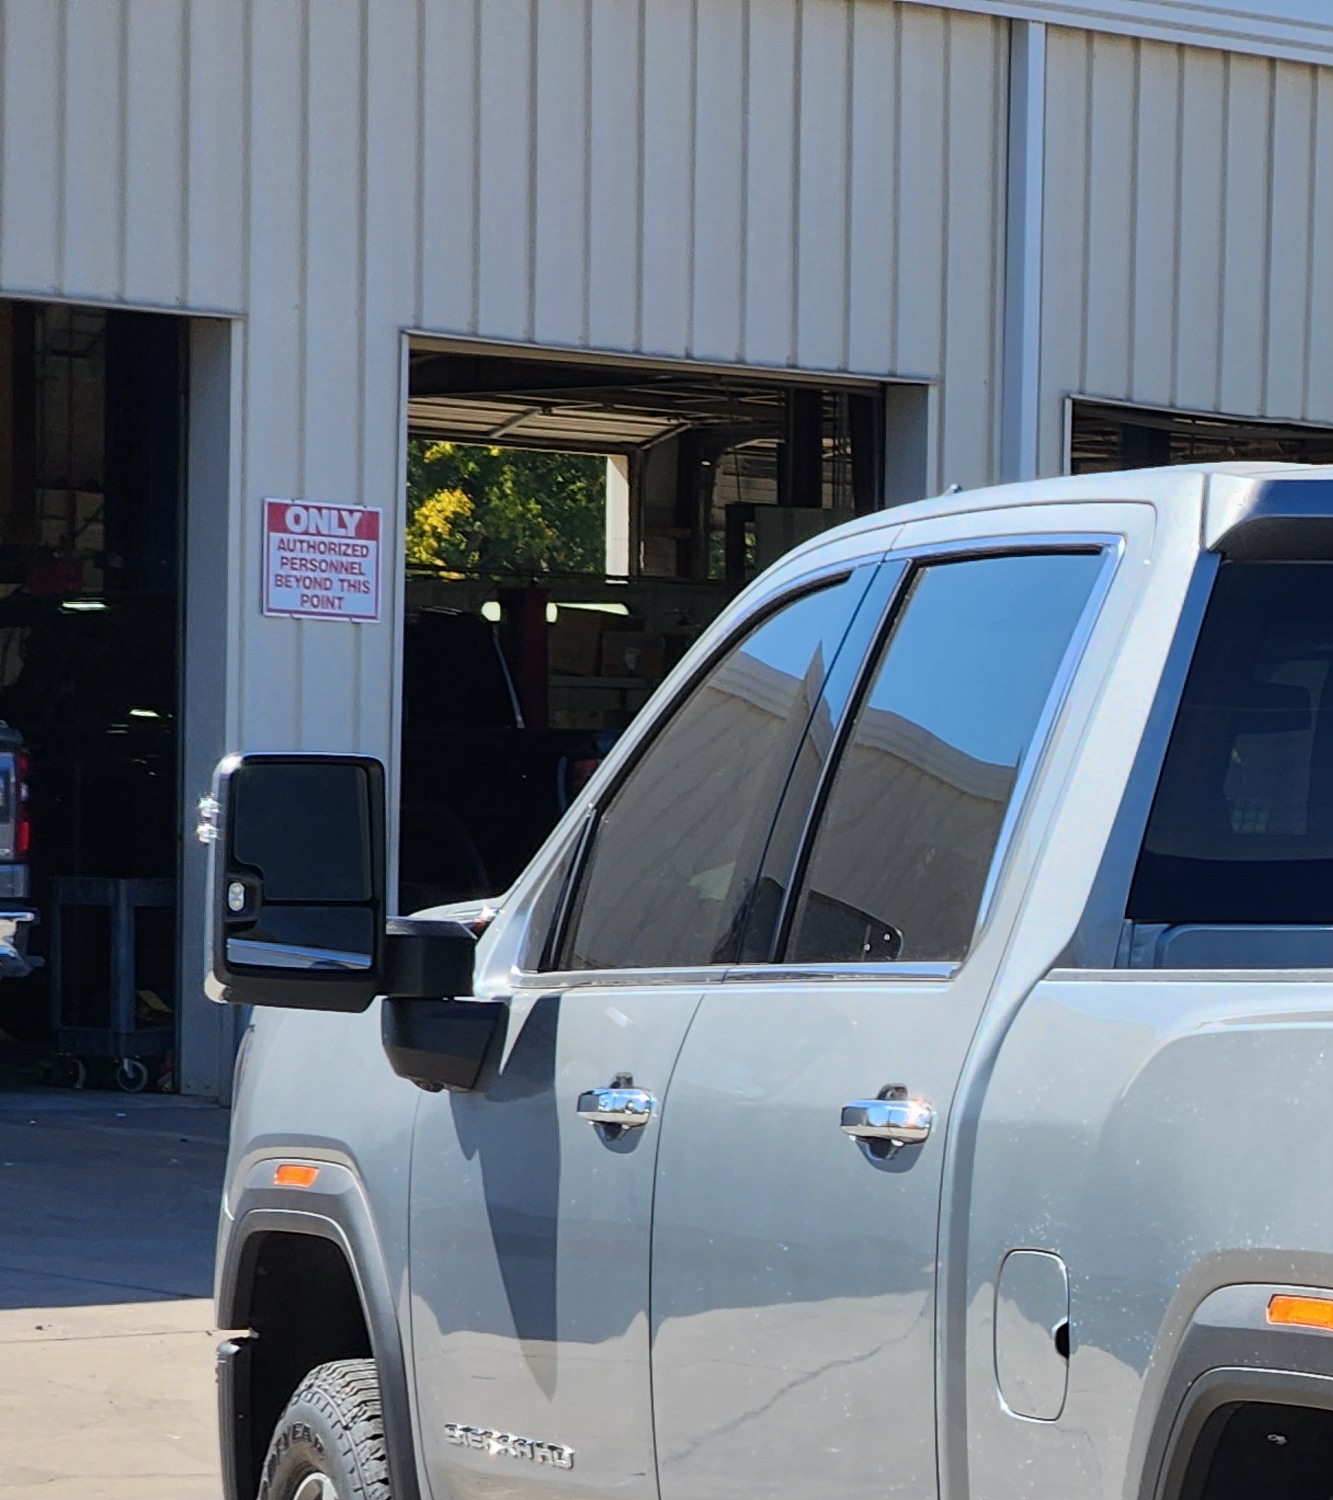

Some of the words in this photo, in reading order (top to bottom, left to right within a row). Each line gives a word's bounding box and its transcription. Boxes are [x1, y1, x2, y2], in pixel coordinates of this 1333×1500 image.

[285, 506, 362, 536] ONLY
[276, 538, 369, 558] AUTHORIZED
[280, 556, 366, 575] PERSONNEL
[274, 574, 333, 591] BEYOND
[338, 578, 371, 594] THIS
[300, 593, 344, 610] POINT
